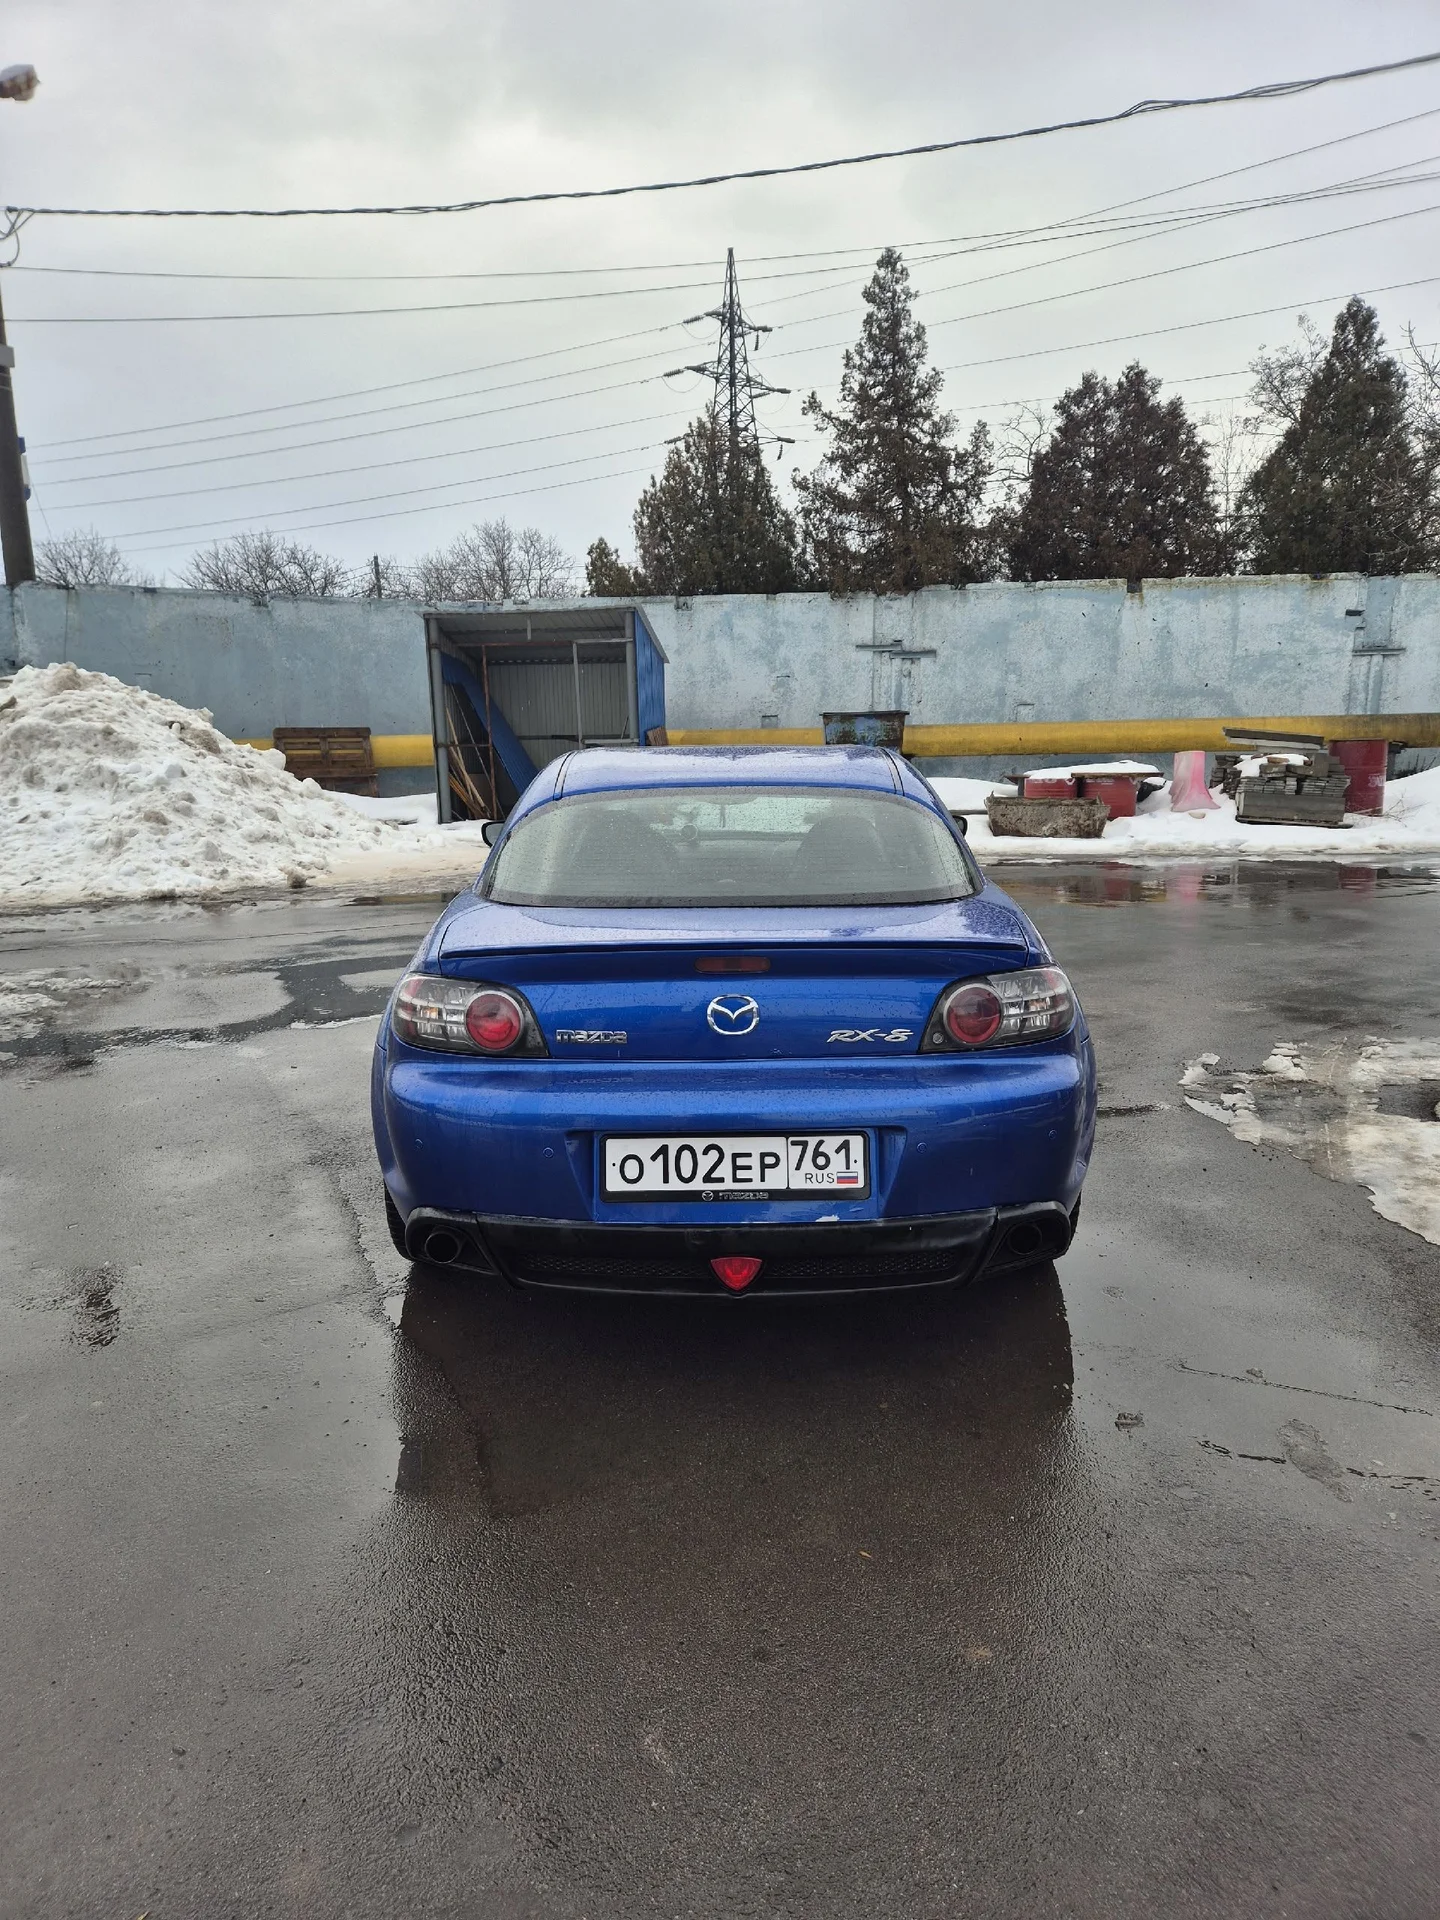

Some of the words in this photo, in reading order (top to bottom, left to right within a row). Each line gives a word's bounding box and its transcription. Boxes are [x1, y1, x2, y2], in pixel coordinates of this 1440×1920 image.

[827, 1028, 914, 1044] RX-8
[789, 1139, 852, 1171] 761
[804, 1172, 835, 1184] RUS
